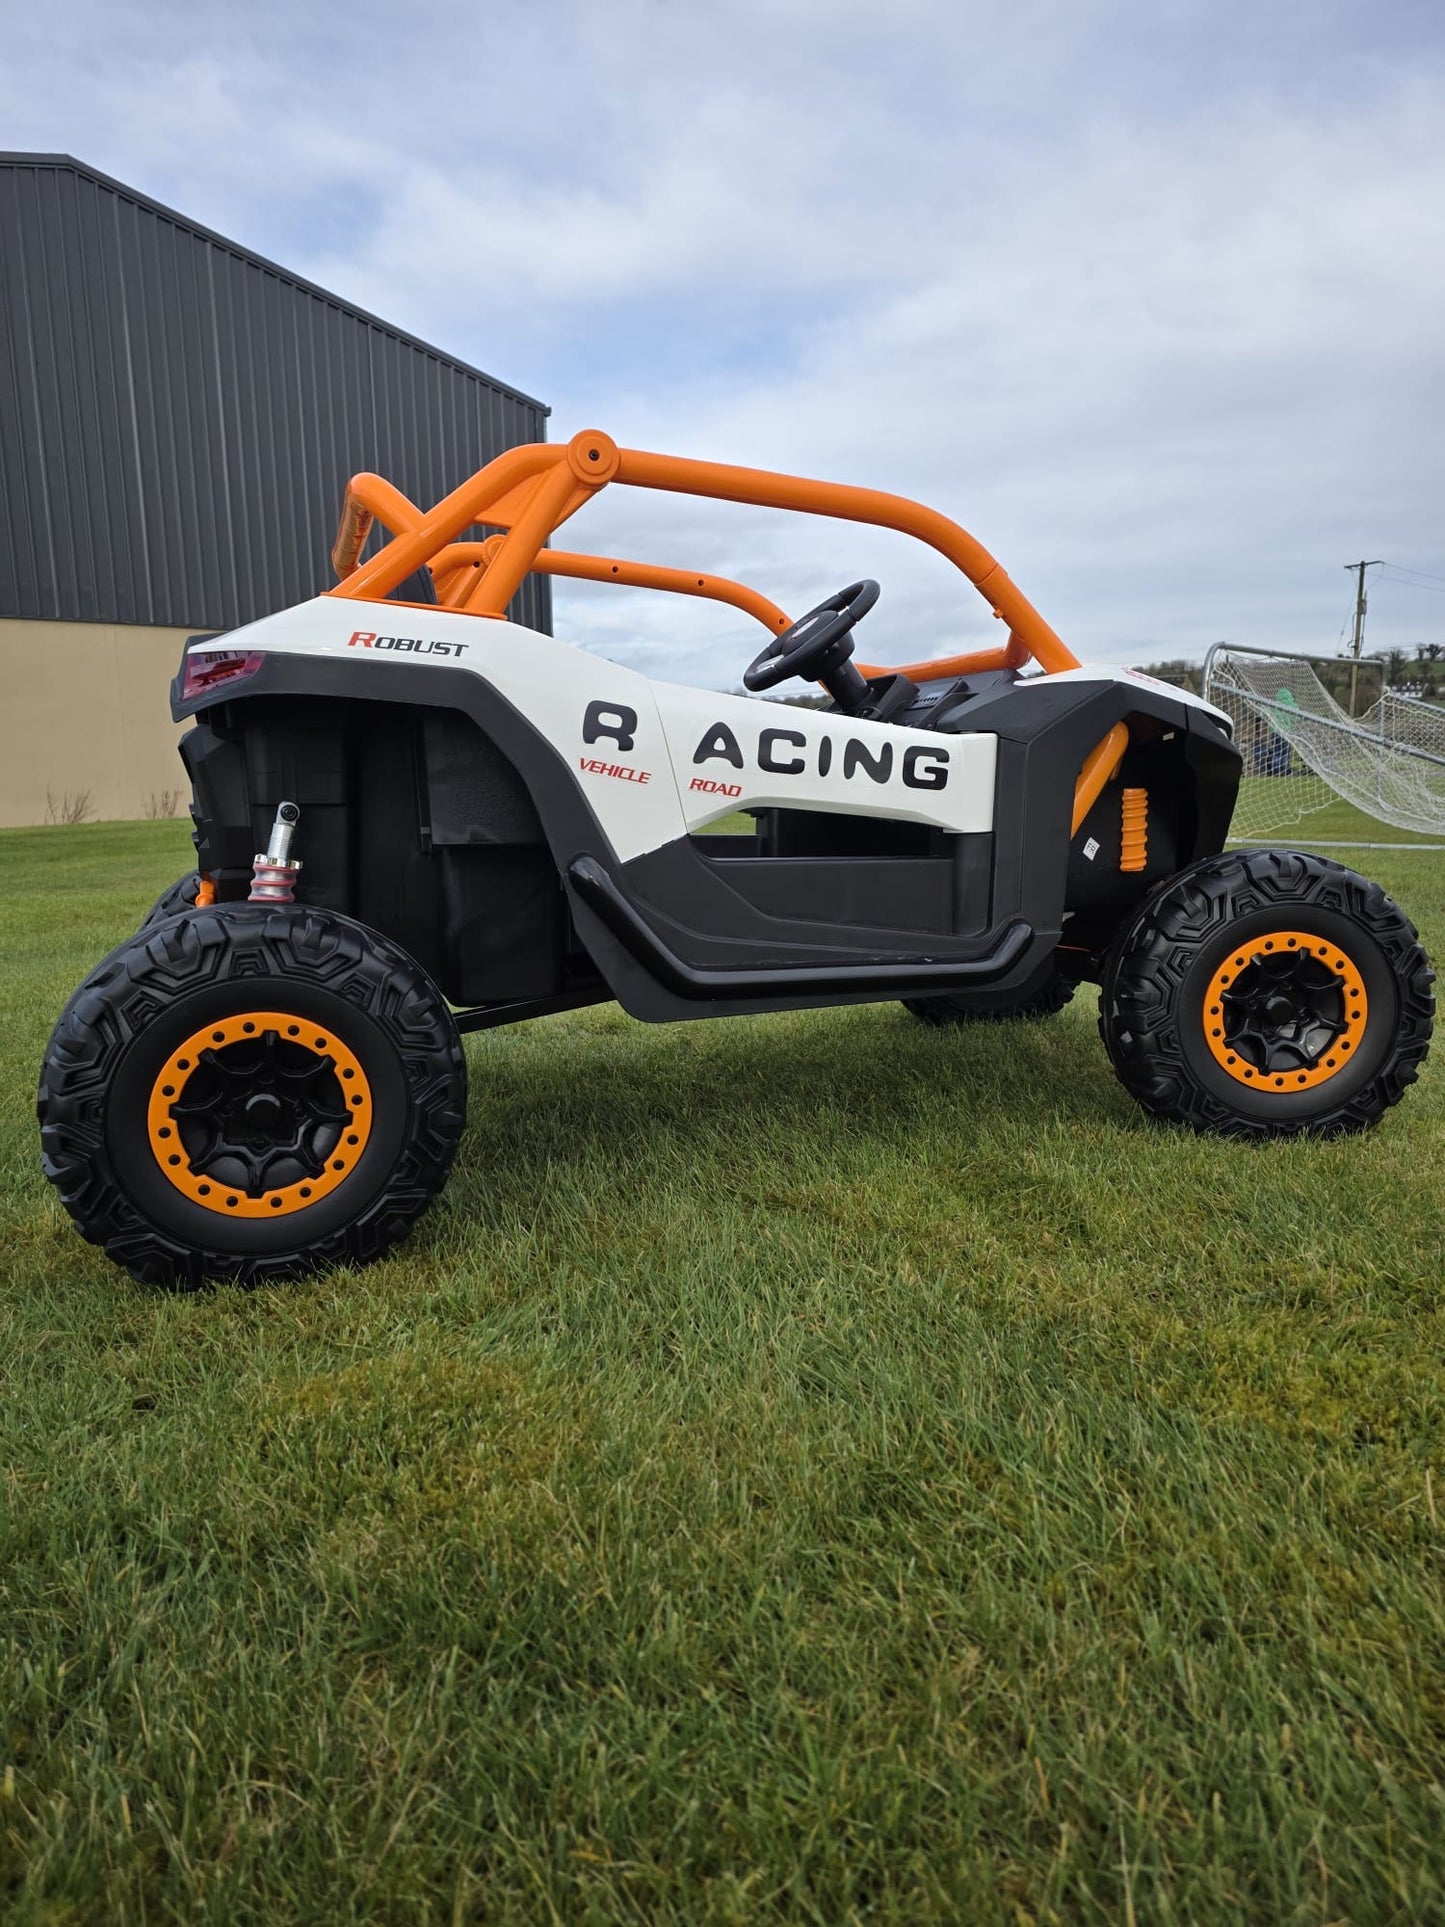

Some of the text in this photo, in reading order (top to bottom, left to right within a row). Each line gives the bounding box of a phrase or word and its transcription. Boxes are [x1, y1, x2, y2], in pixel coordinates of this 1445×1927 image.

[348, 631, 470, 657] ROBUST
[582, 700, 638, 752] R
[580, 757, 743, 797] VEHICLE ROAD
